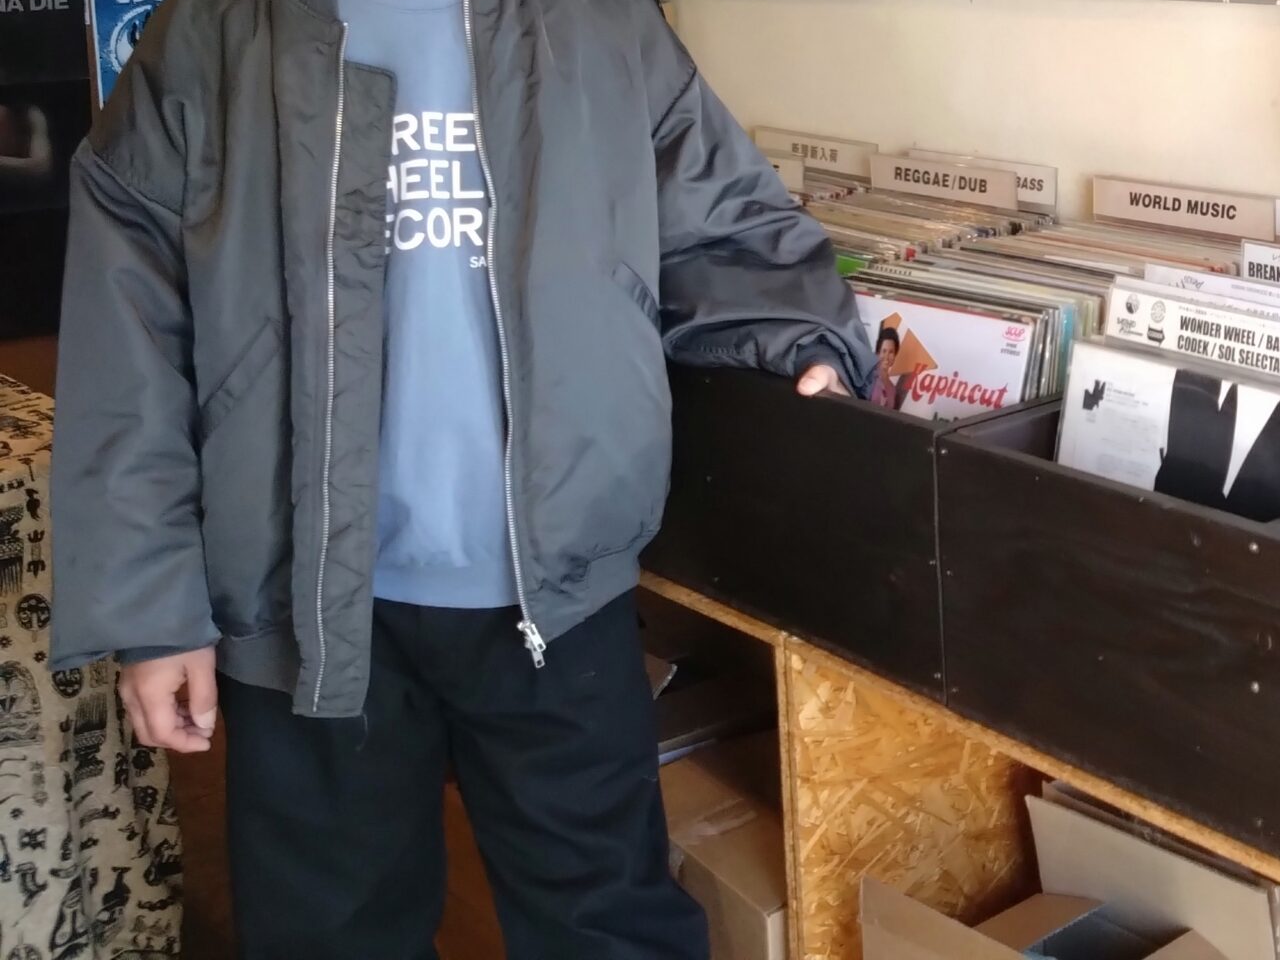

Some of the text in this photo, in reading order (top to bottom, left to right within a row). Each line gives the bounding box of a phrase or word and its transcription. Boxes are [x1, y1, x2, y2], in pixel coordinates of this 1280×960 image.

[391, 111, 476, 155] REE
[893, 166, 987, 194] REGGAE/DUB
[1129, 191, 1237, 220] WORLD MUSIC
[1180, 315, 1223, 339] WONDER
[1223, 324, 1256, 347] WHEEL
[1177, 335, 1209, 357] CODEK
[1217, 344, 1236, 363] SOL
